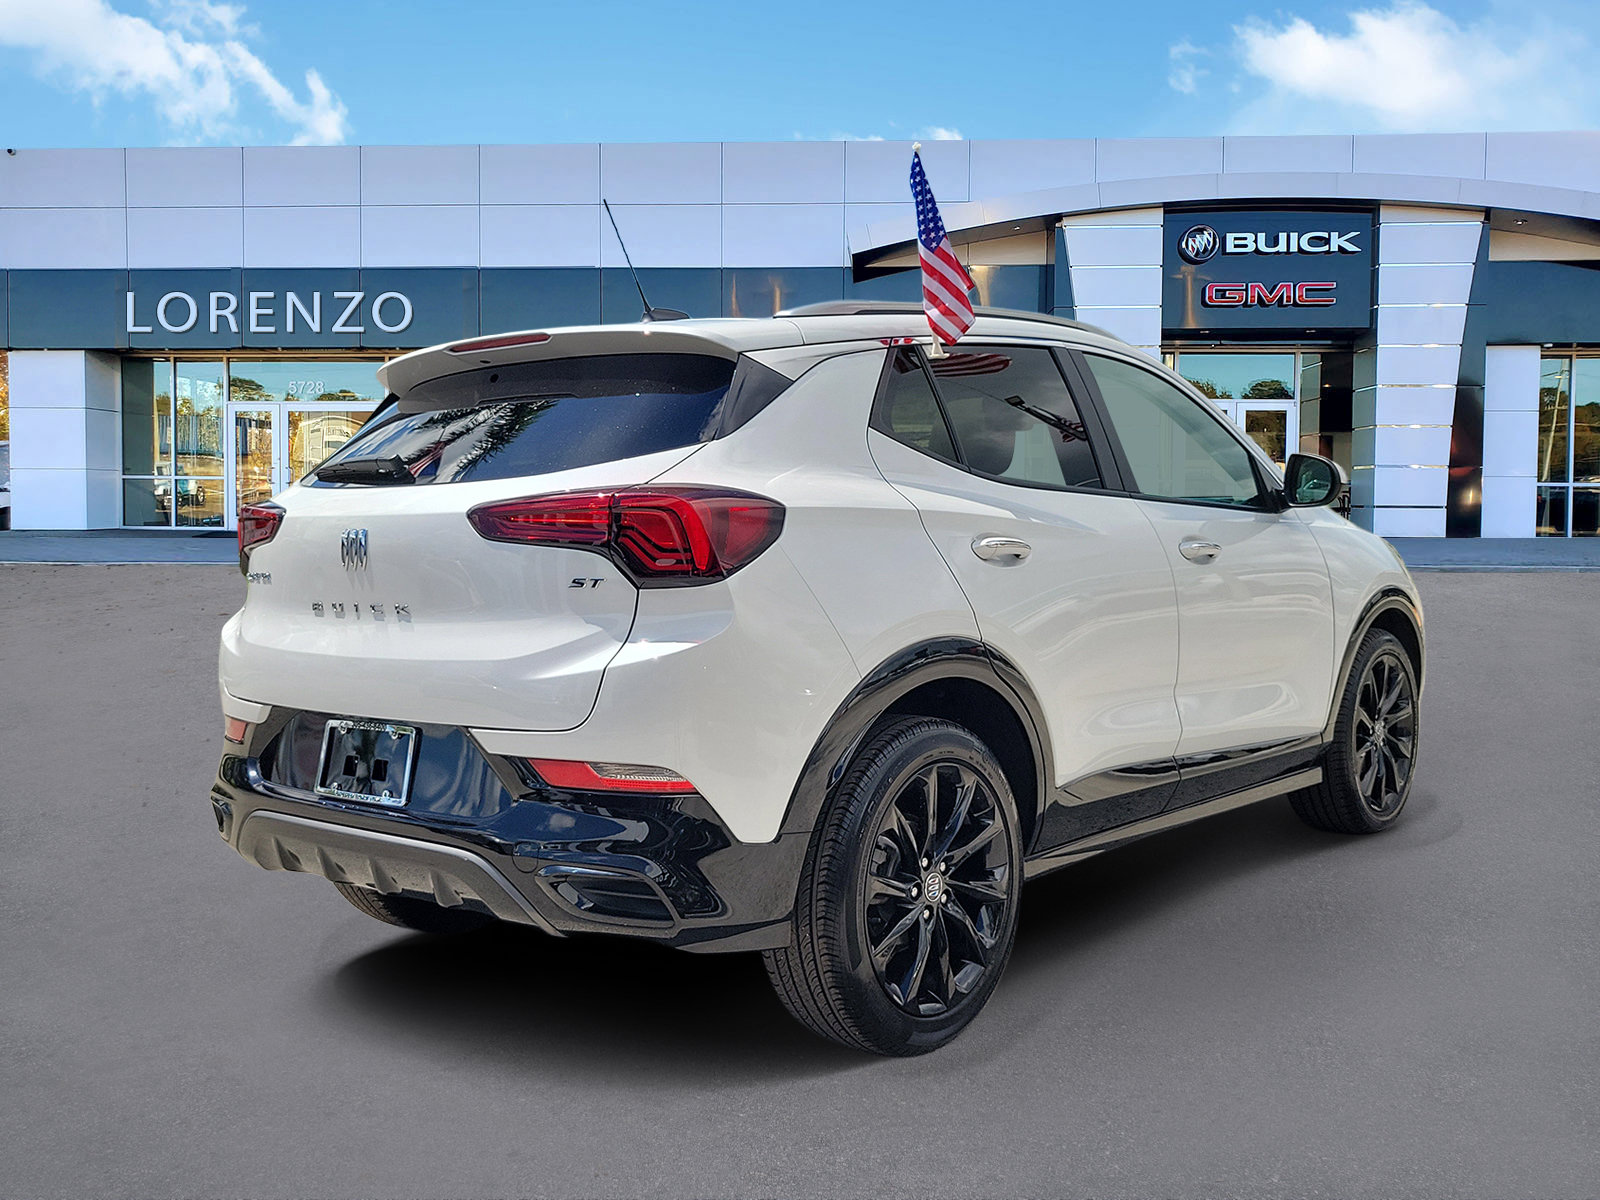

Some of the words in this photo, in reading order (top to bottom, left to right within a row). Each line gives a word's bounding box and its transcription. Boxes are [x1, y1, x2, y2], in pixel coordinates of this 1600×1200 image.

[1225, 231, 1362, 253] BUICK
[1204, 281, 1337, 306] GMC
[126, 291, 413, 333] LORENZO
[288, 381, 325, 394] 5728
[568, 577, 607, 589] ST
[312, 602, 410, 615] BUICK
